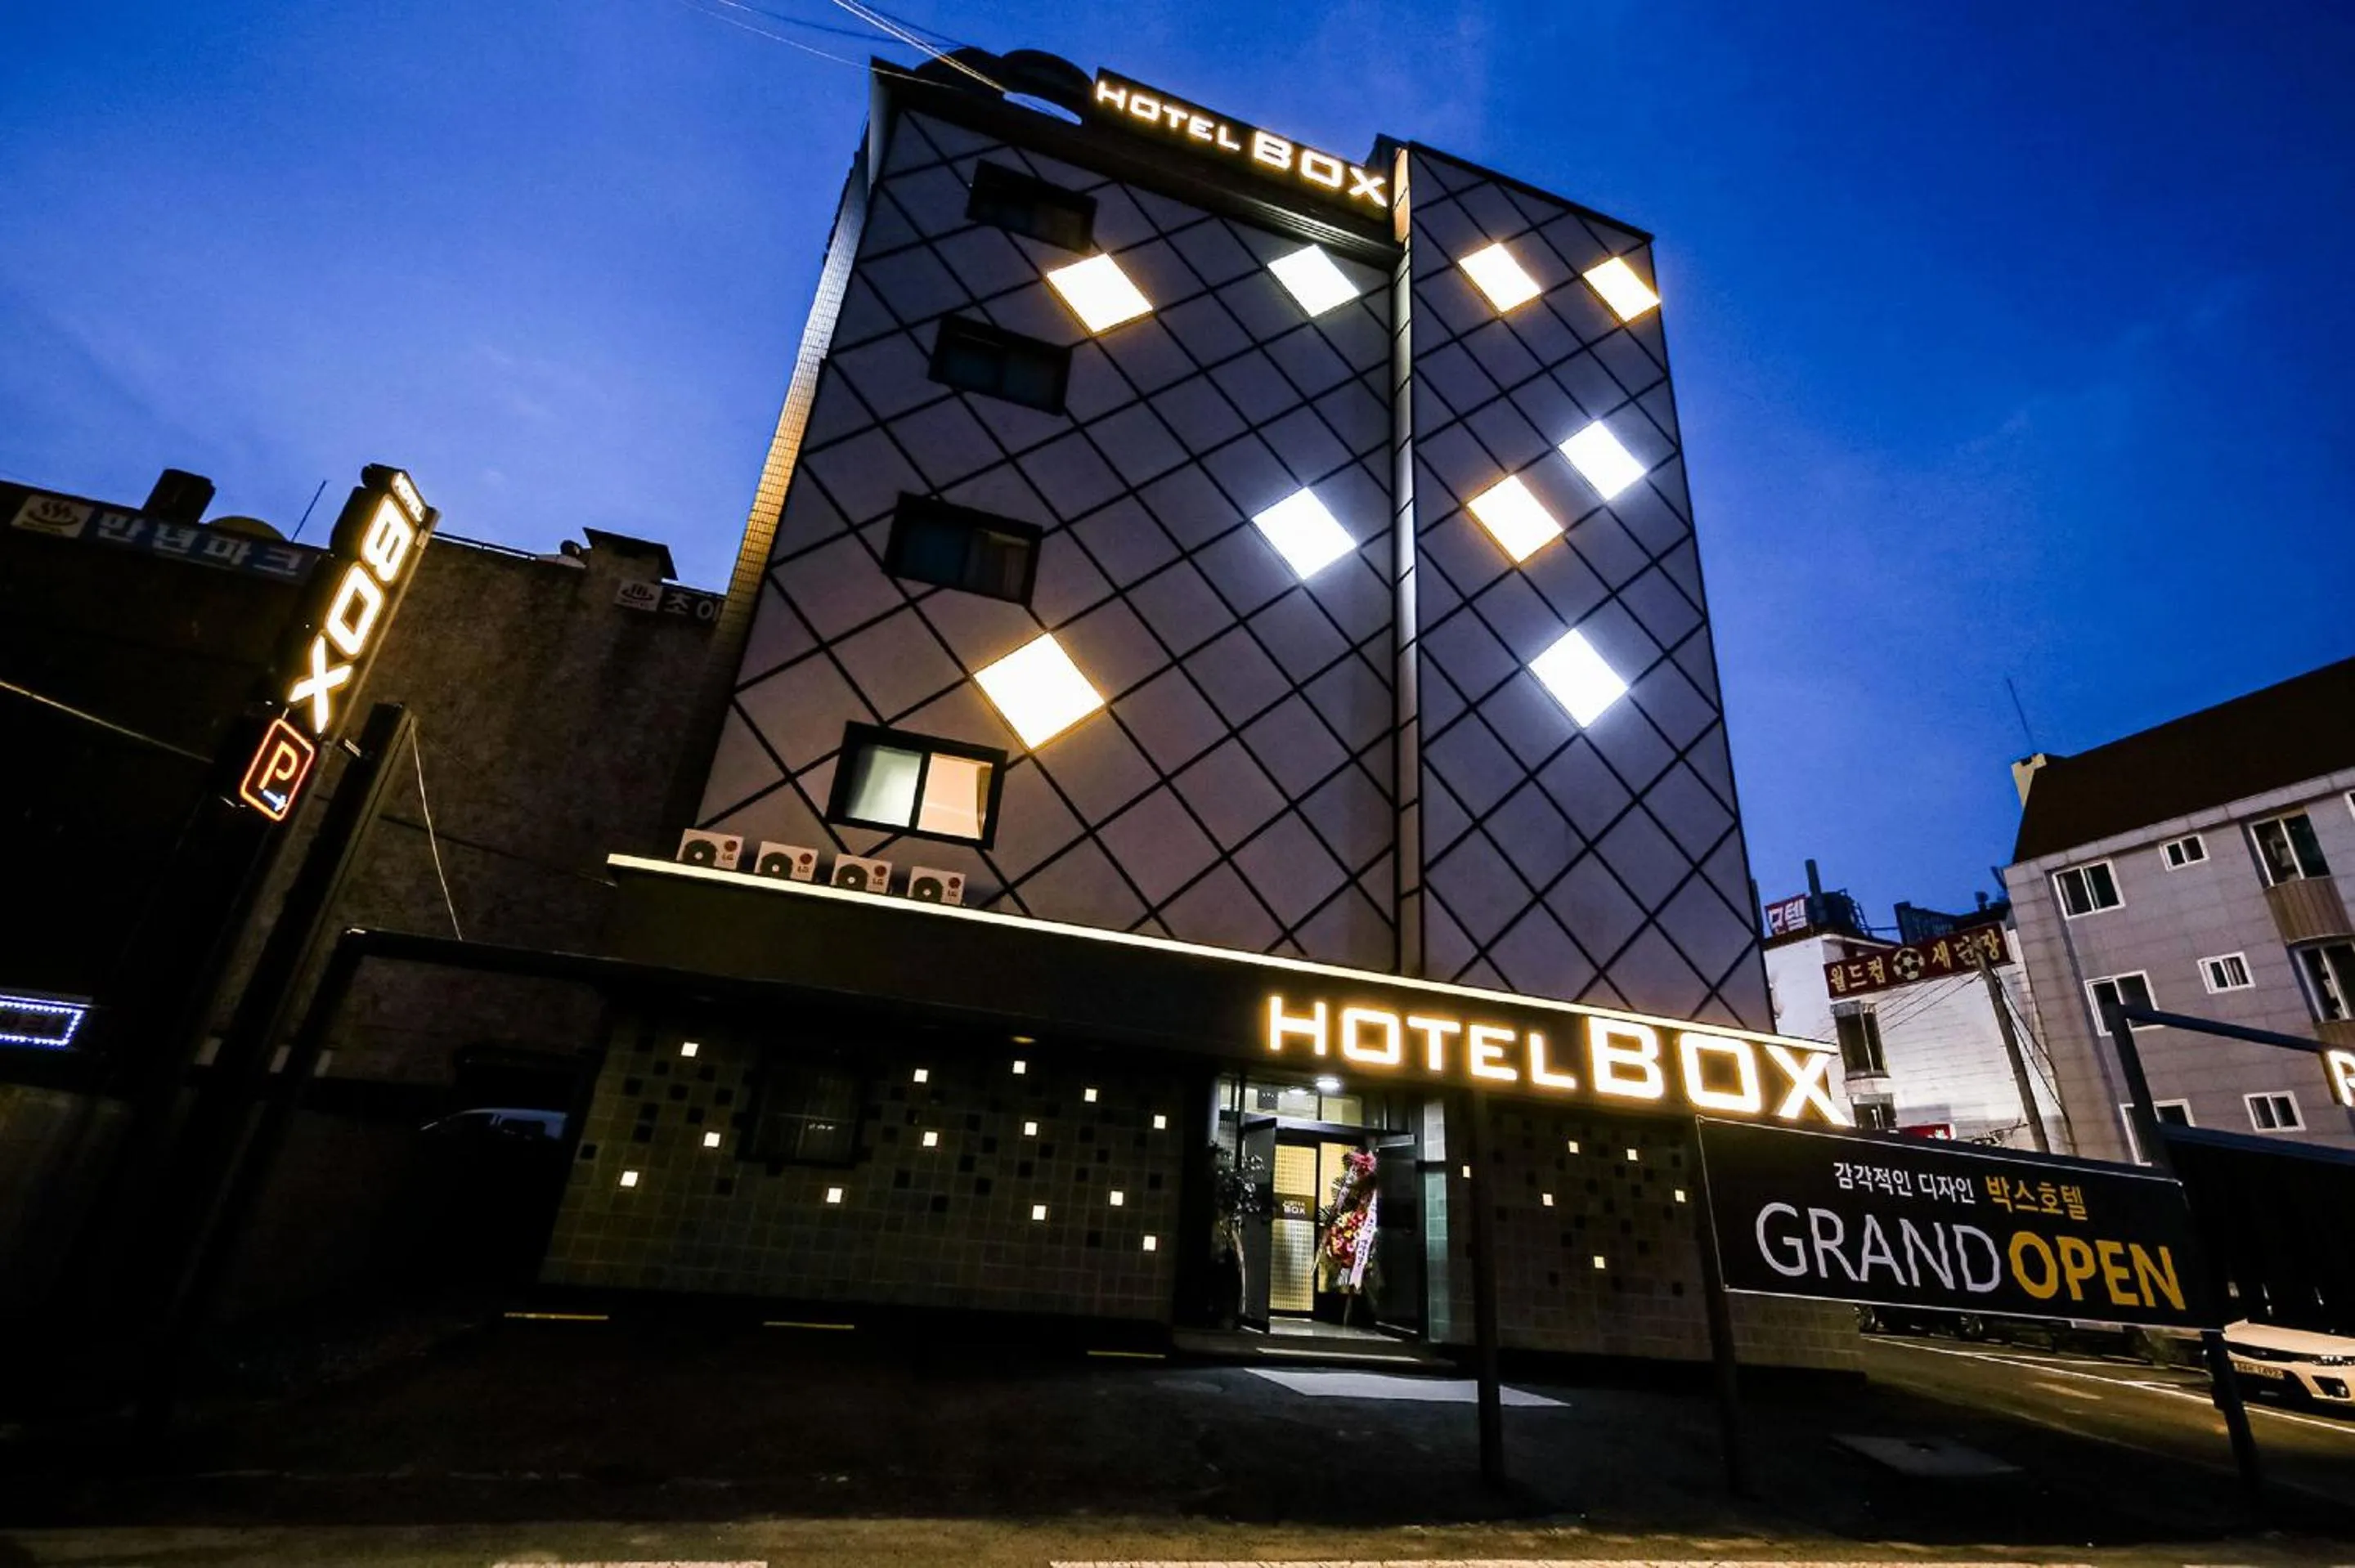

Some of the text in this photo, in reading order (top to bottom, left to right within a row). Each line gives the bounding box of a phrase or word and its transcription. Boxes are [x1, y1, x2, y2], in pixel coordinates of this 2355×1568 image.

[1097, 81, 1388, 207] HOTEL BOX
[289, 495, 415, 734] BOX
[258, 740, 298, 790] P
[1767, 898, 1807, 935] 모텔
[1830, 955, 1886, 993] 월드컵
[1269, 996, 1851, 1127] HOTEL BOX
[1833, 1162, 2088, 1221] 감각적인 디자인 박스호텔
[1756, 1202, 2186, 1310] GRAND OPEN
